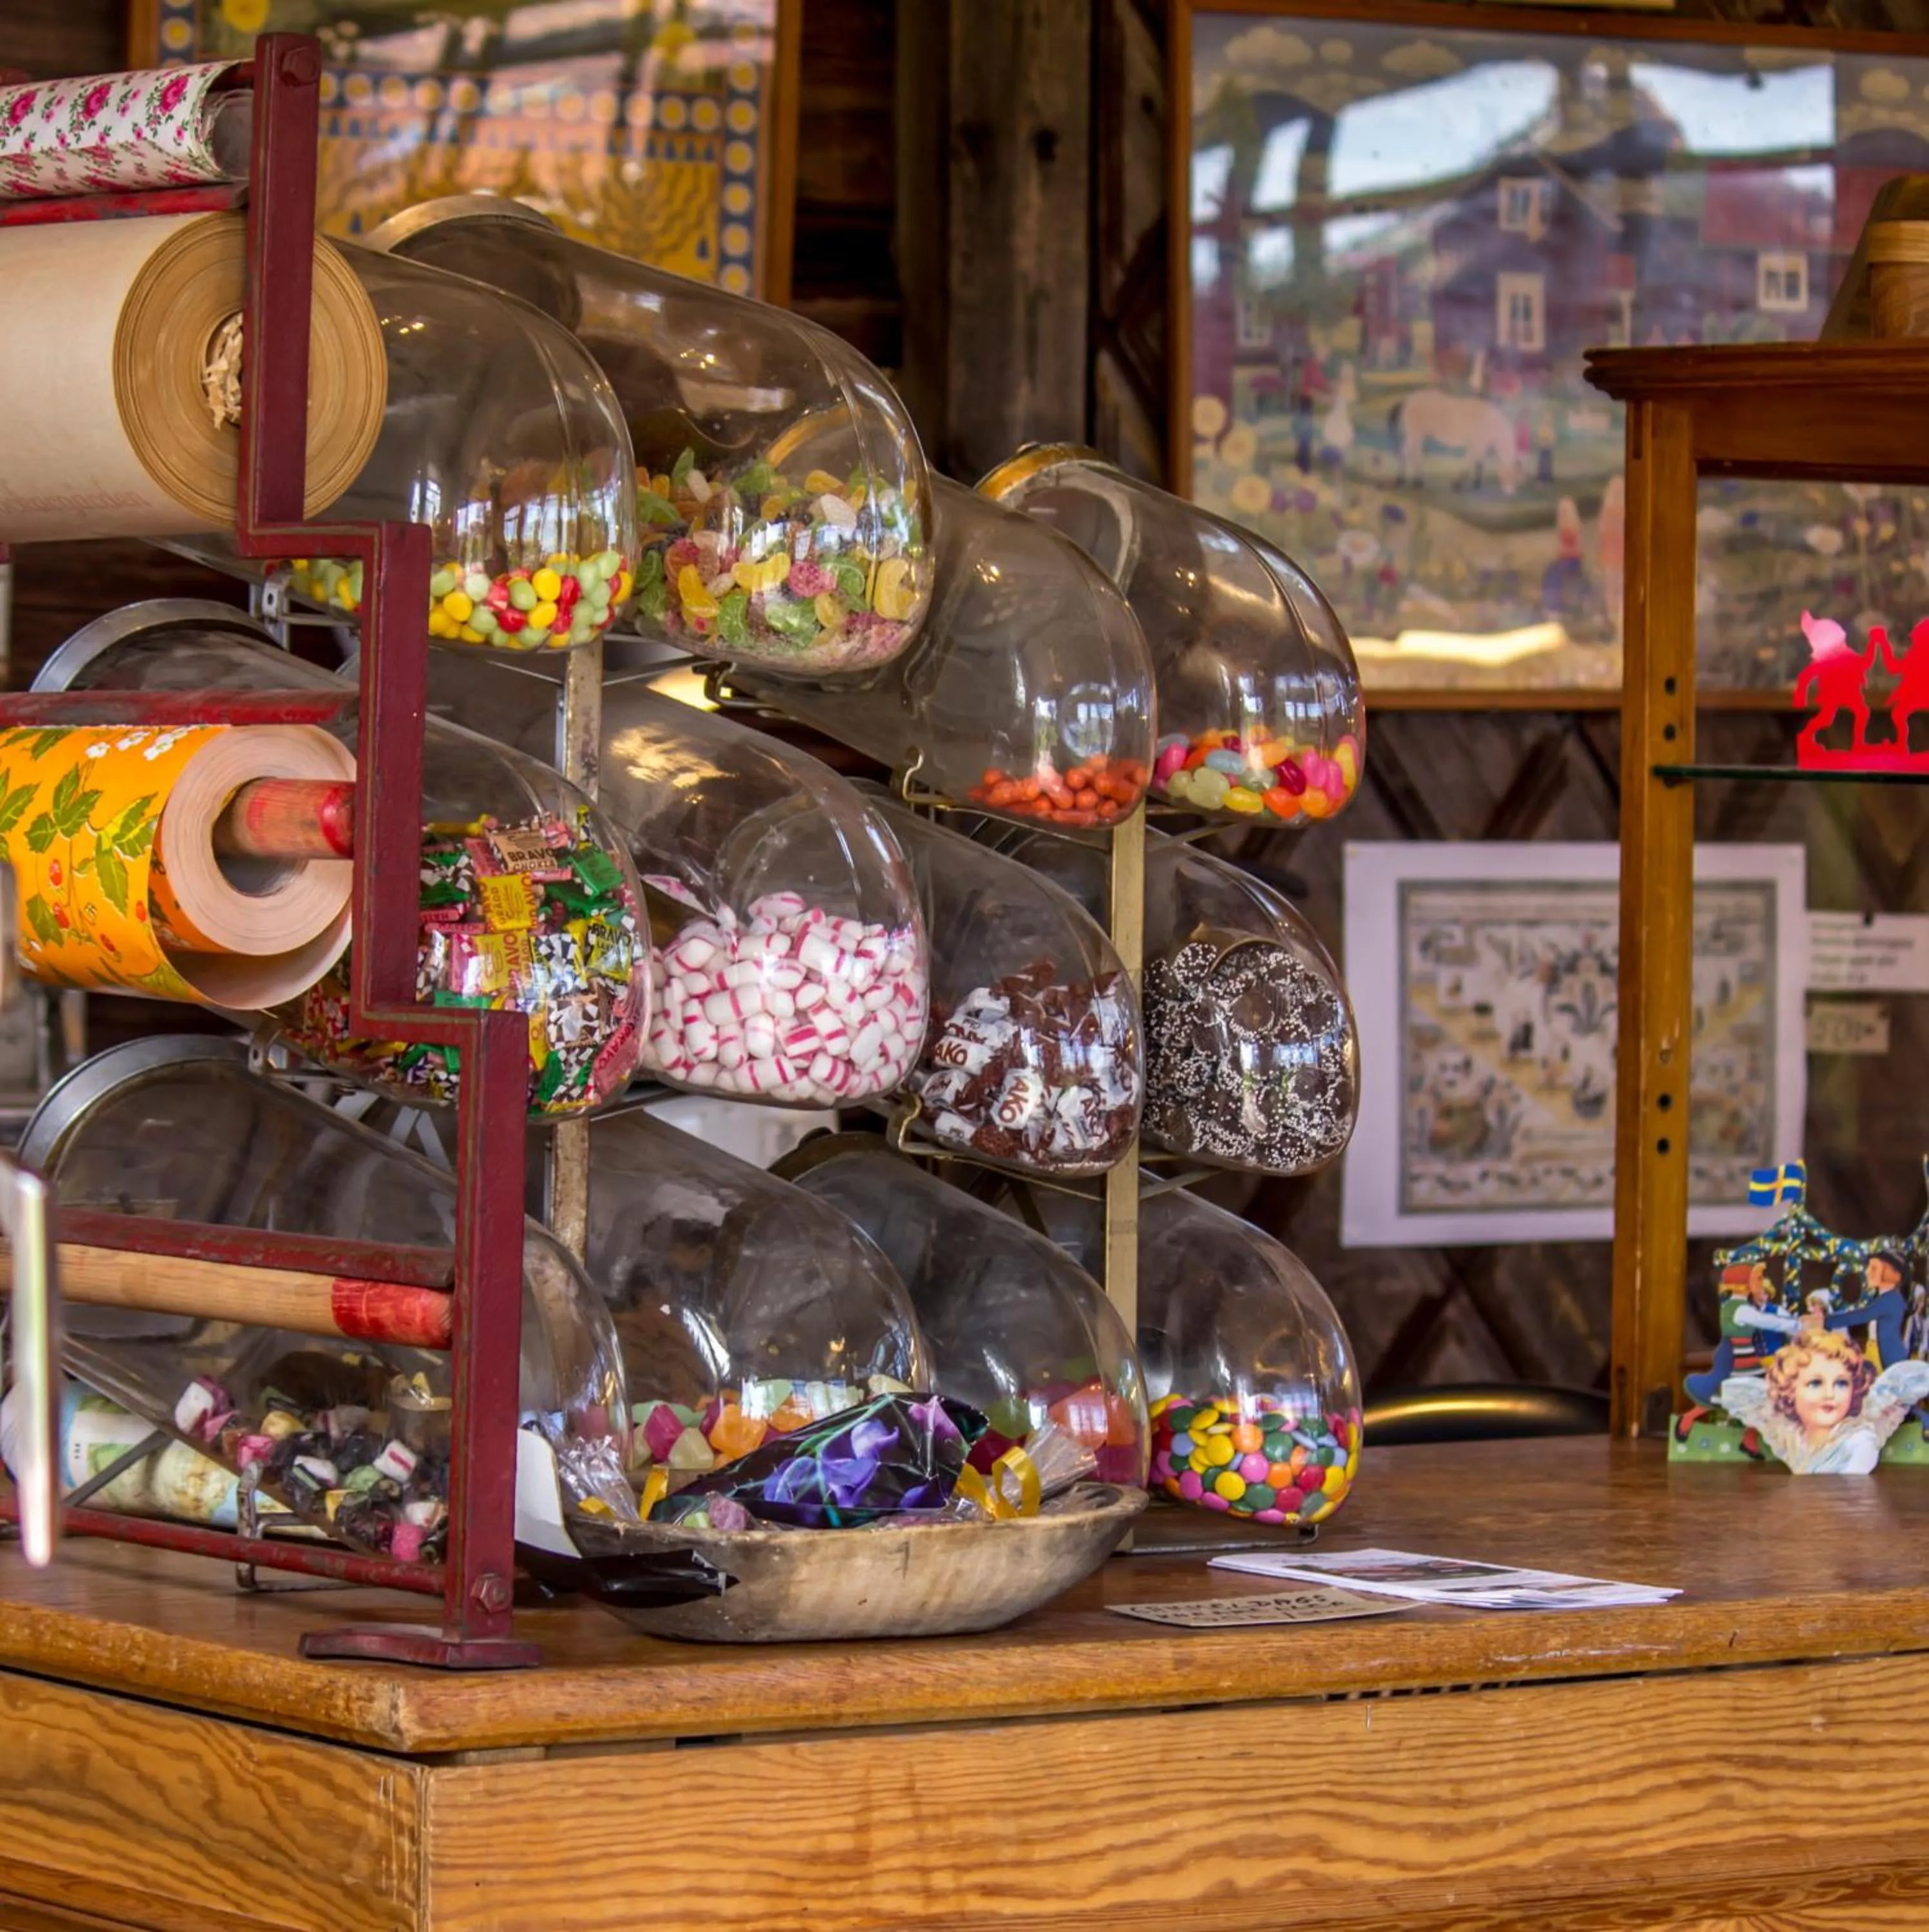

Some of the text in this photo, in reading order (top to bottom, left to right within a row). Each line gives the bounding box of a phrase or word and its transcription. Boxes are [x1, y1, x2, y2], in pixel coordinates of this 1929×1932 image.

[507, 847, 558, 862] BRAVO
[935, 1041, 968, 1065] AKO
[999, 1077, 1030, 1123] AKO
